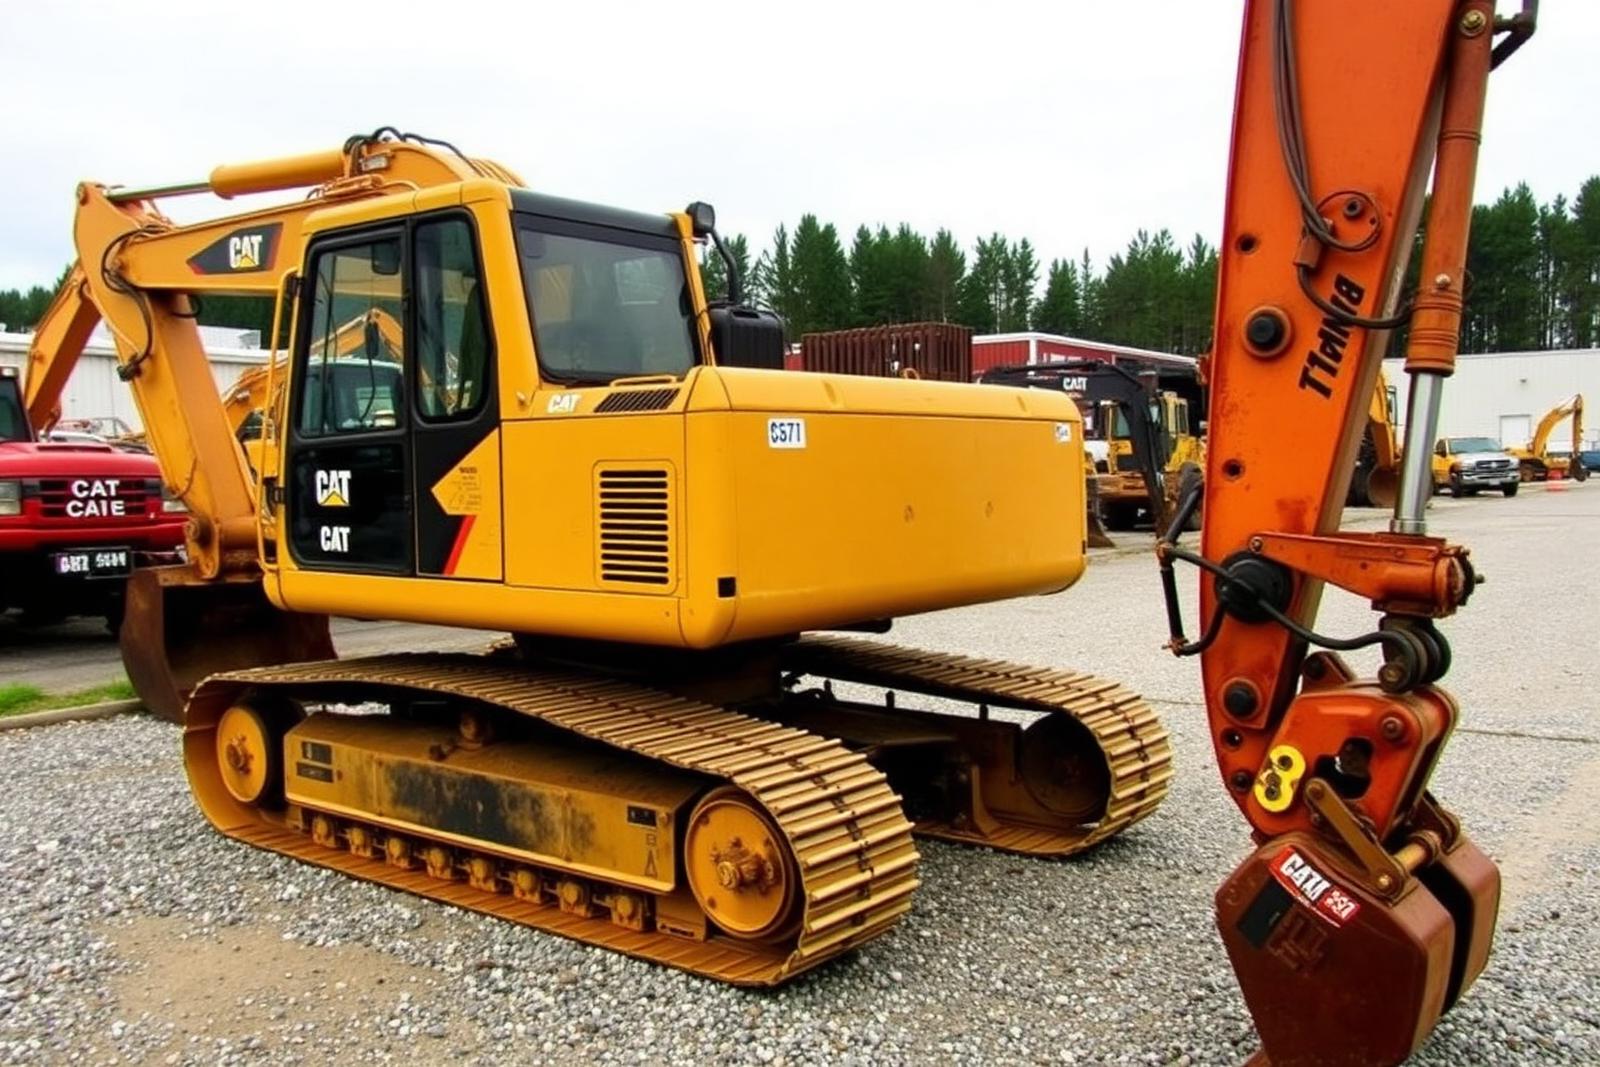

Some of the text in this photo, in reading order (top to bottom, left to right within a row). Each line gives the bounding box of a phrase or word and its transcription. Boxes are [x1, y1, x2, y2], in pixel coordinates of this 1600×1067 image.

[229, 235, 263, 268] CAT
[71, 480, 120, 497] CAT
[316, 470, 352, 506] CAT
[320, 526, 351, 552] CAT
